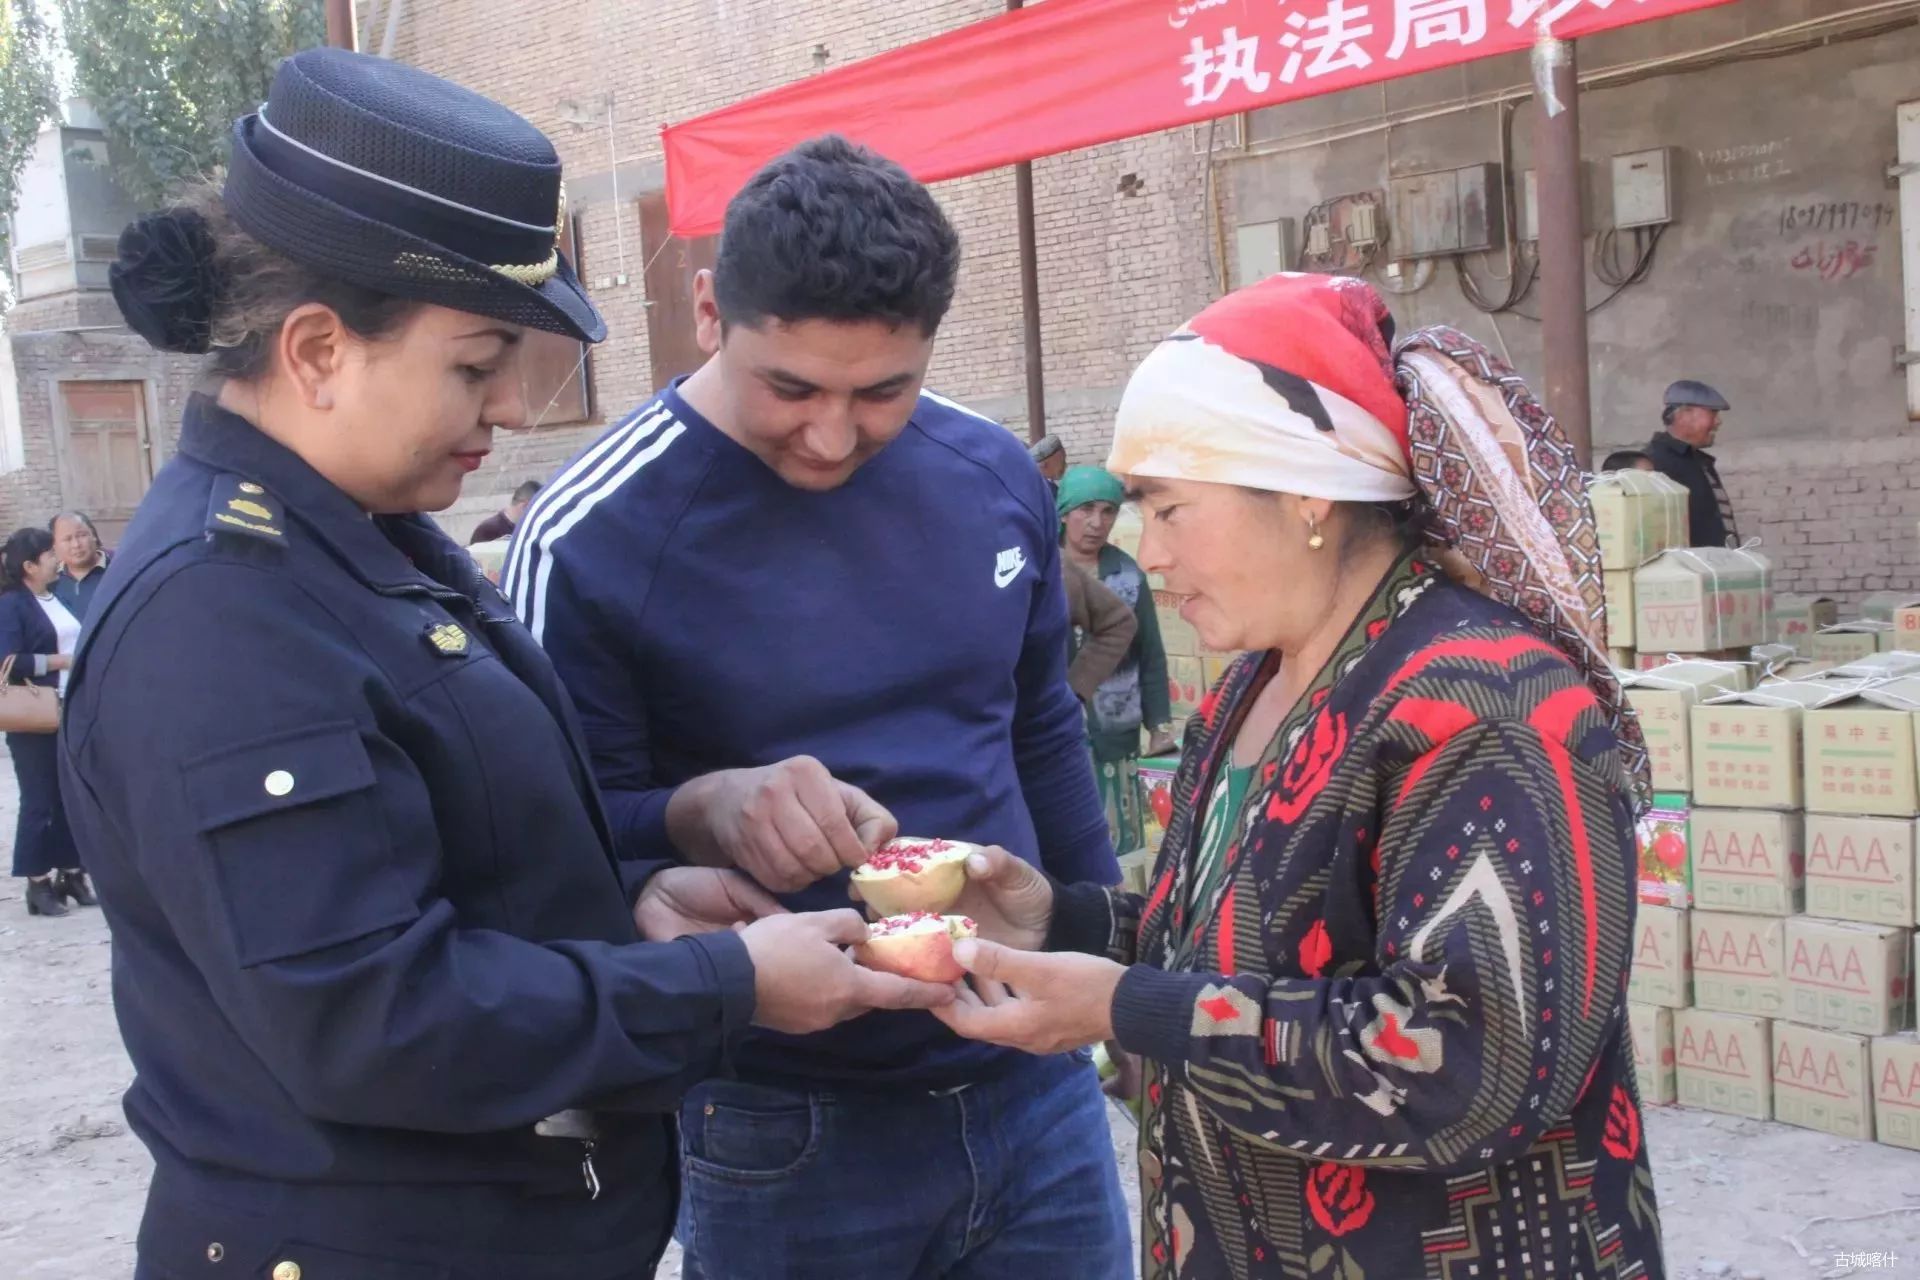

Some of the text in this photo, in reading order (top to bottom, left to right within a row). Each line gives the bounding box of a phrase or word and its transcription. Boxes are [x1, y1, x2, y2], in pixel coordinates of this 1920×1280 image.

[1903, 613, 1920, 631] 8
[1700, 829, 1771, 869] AAA
[1808, 832, 1890, 875] AAA
[1695, 928, 1767, 969] AAA
[1791, 937, 1867, 986] AAA
[1680, 1026, 1747, 1071] AAA
[1775, 1041, 1845, 1090] AAA
